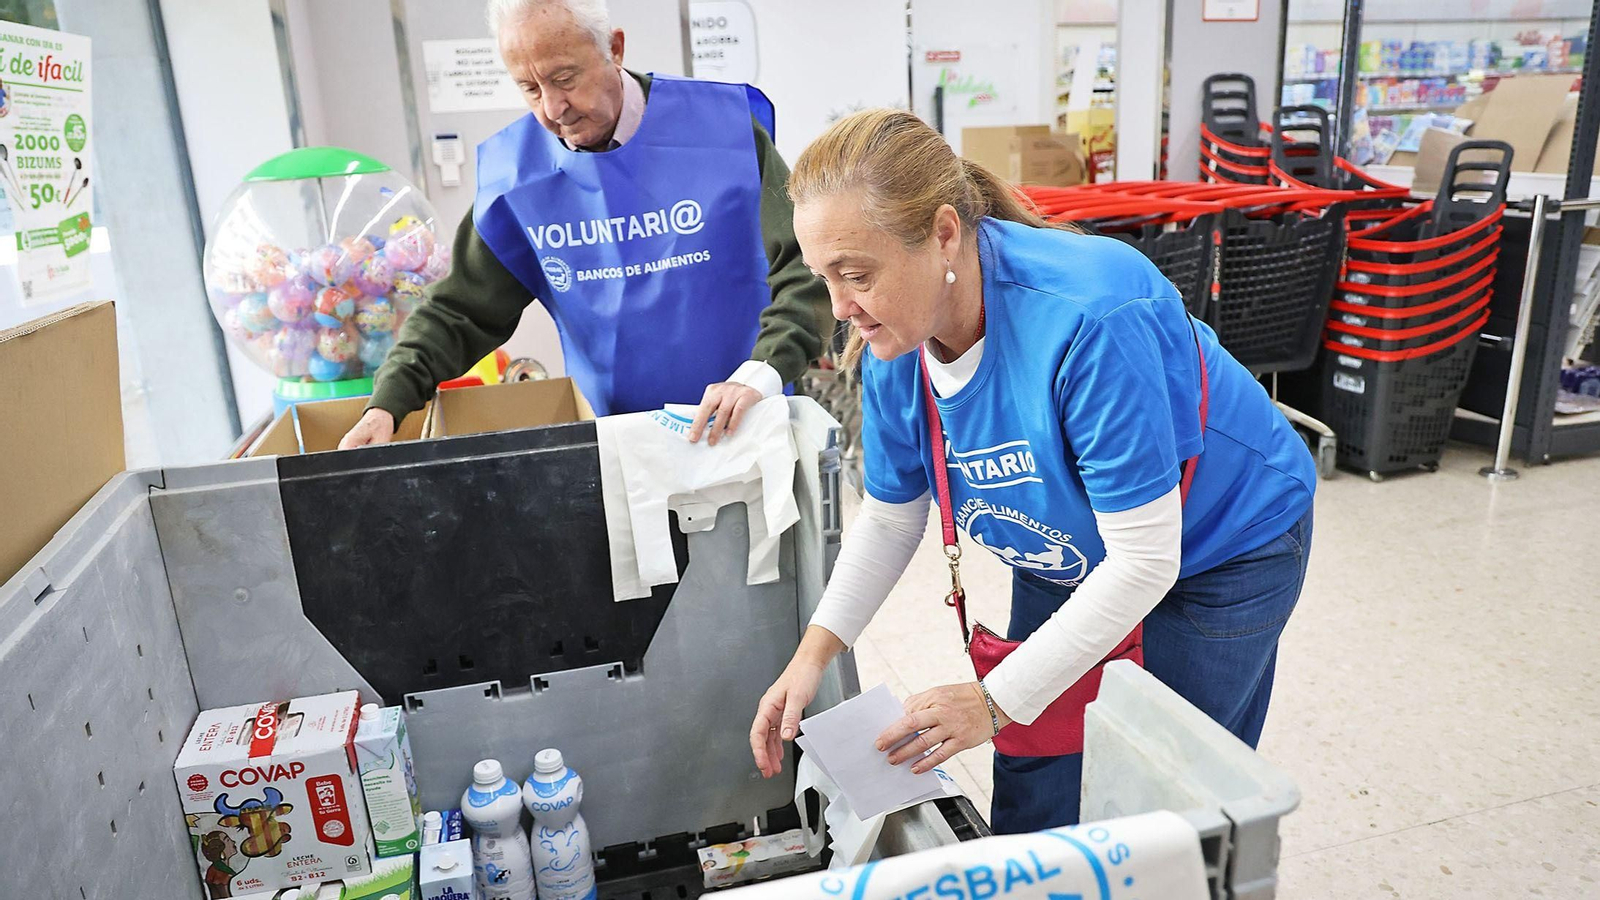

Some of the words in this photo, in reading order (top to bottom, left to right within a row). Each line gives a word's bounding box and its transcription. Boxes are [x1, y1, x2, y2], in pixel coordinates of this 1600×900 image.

[0, 34, 24, 45] ANAR
[10, 52, 35, 76] de
[38, 54, 84, 82] ifacil
[14, 134, 60, 151] 2000
[17, 155, 62, 169] BIZUMS
[527, 199, 706, 250] VOLUNTARI@
[577, 268, 624, 282] BANCOS
[625, 263, 642, 277] DE
[644, 250, 711, 274] ALIMENTOS
[949, 445, 1036, 481] NTARIO
[219, 761, 306, 788] COVAP
[531, 796, 575, 812] COVAP
[286, 857, 323, 869] ENTERA
[308, 871, 326, 879] B12
[442, 886, 454, 895] LA
